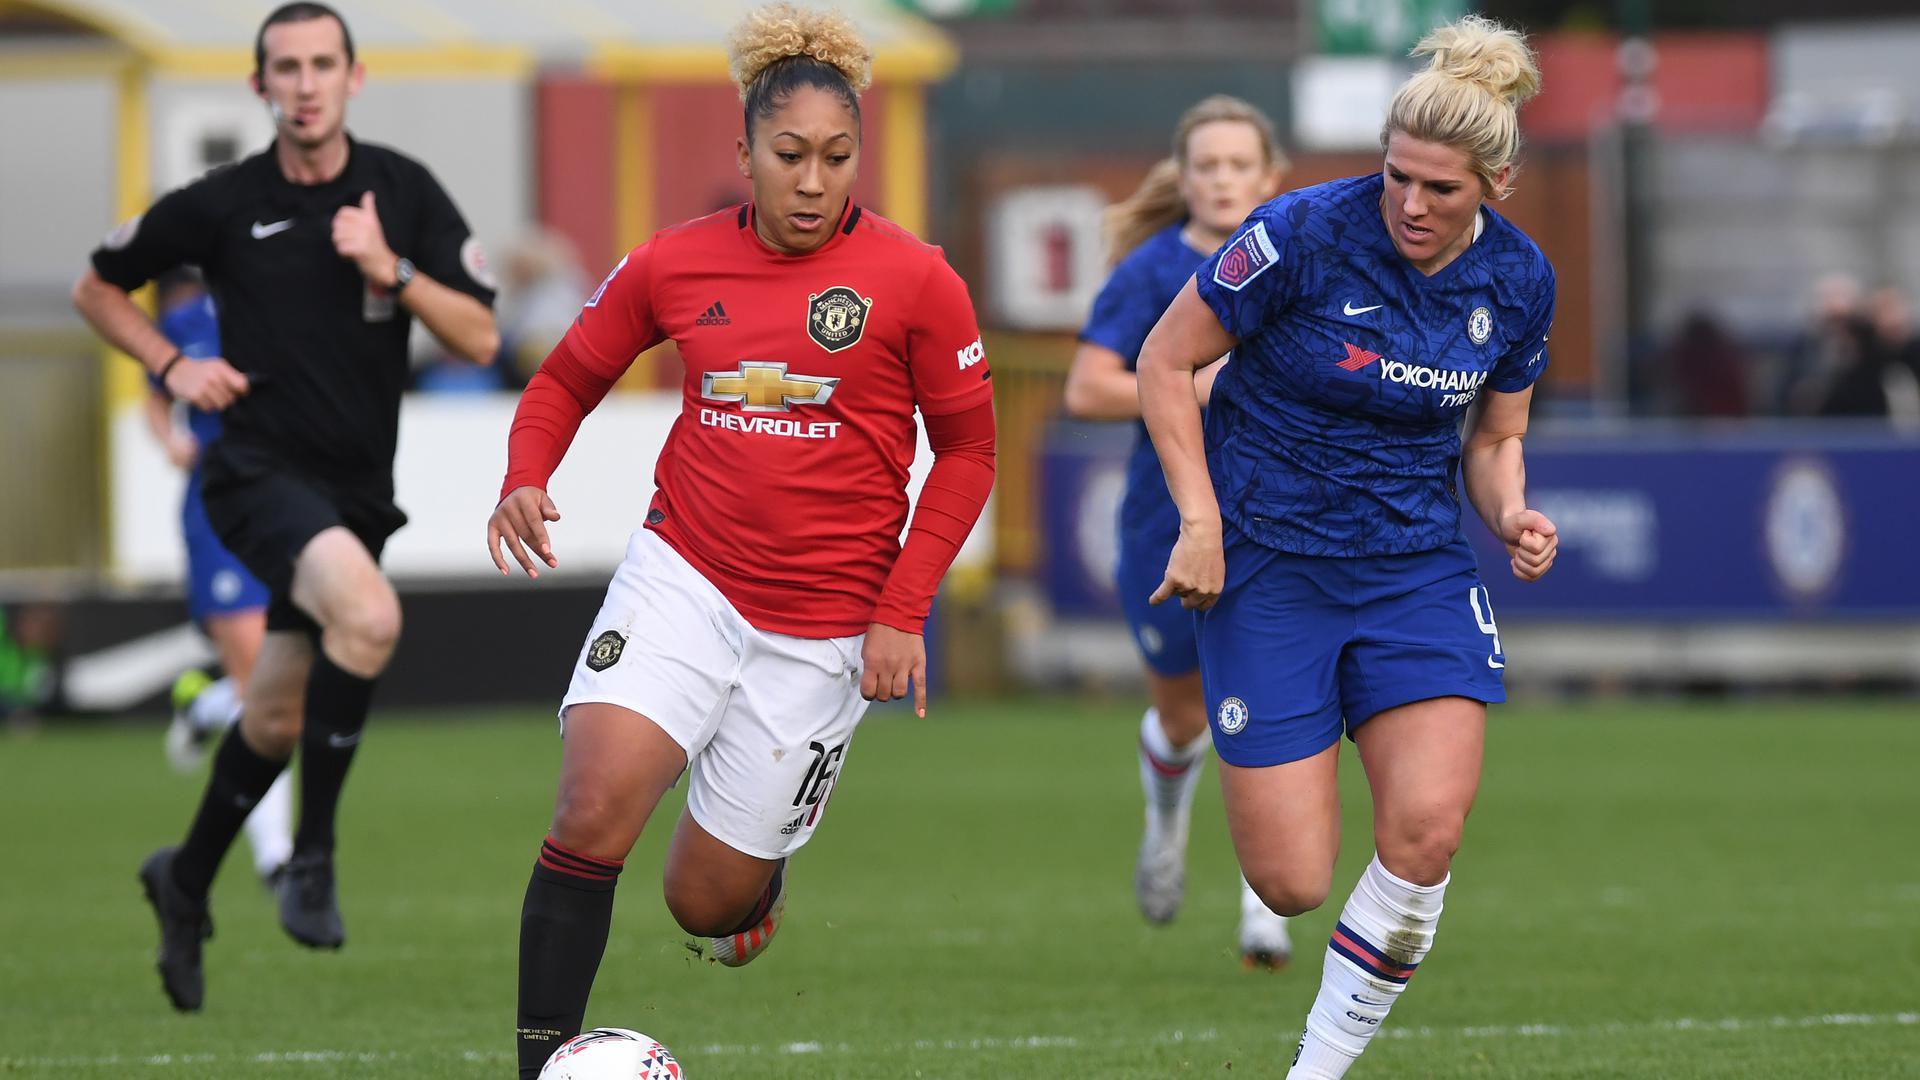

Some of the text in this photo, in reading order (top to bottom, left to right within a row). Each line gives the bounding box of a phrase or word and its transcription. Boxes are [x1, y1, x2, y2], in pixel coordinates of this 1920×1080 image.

[819, 297, 857, 315] MANCHESTER
[696, 317, 731, 326] adidas
[821, 327, 848, 338] UNITED
[1380, 358, 1488, 391] YOKOHAMA
[1440, 389, 1477, 408] TYRES
[700, 408, 842, 439] CHEVROLET
[1469, 586, 1501, 655] 4
[792, 741, 845, 807] 16
[1346, 1010, 1379, 1025] CFC
